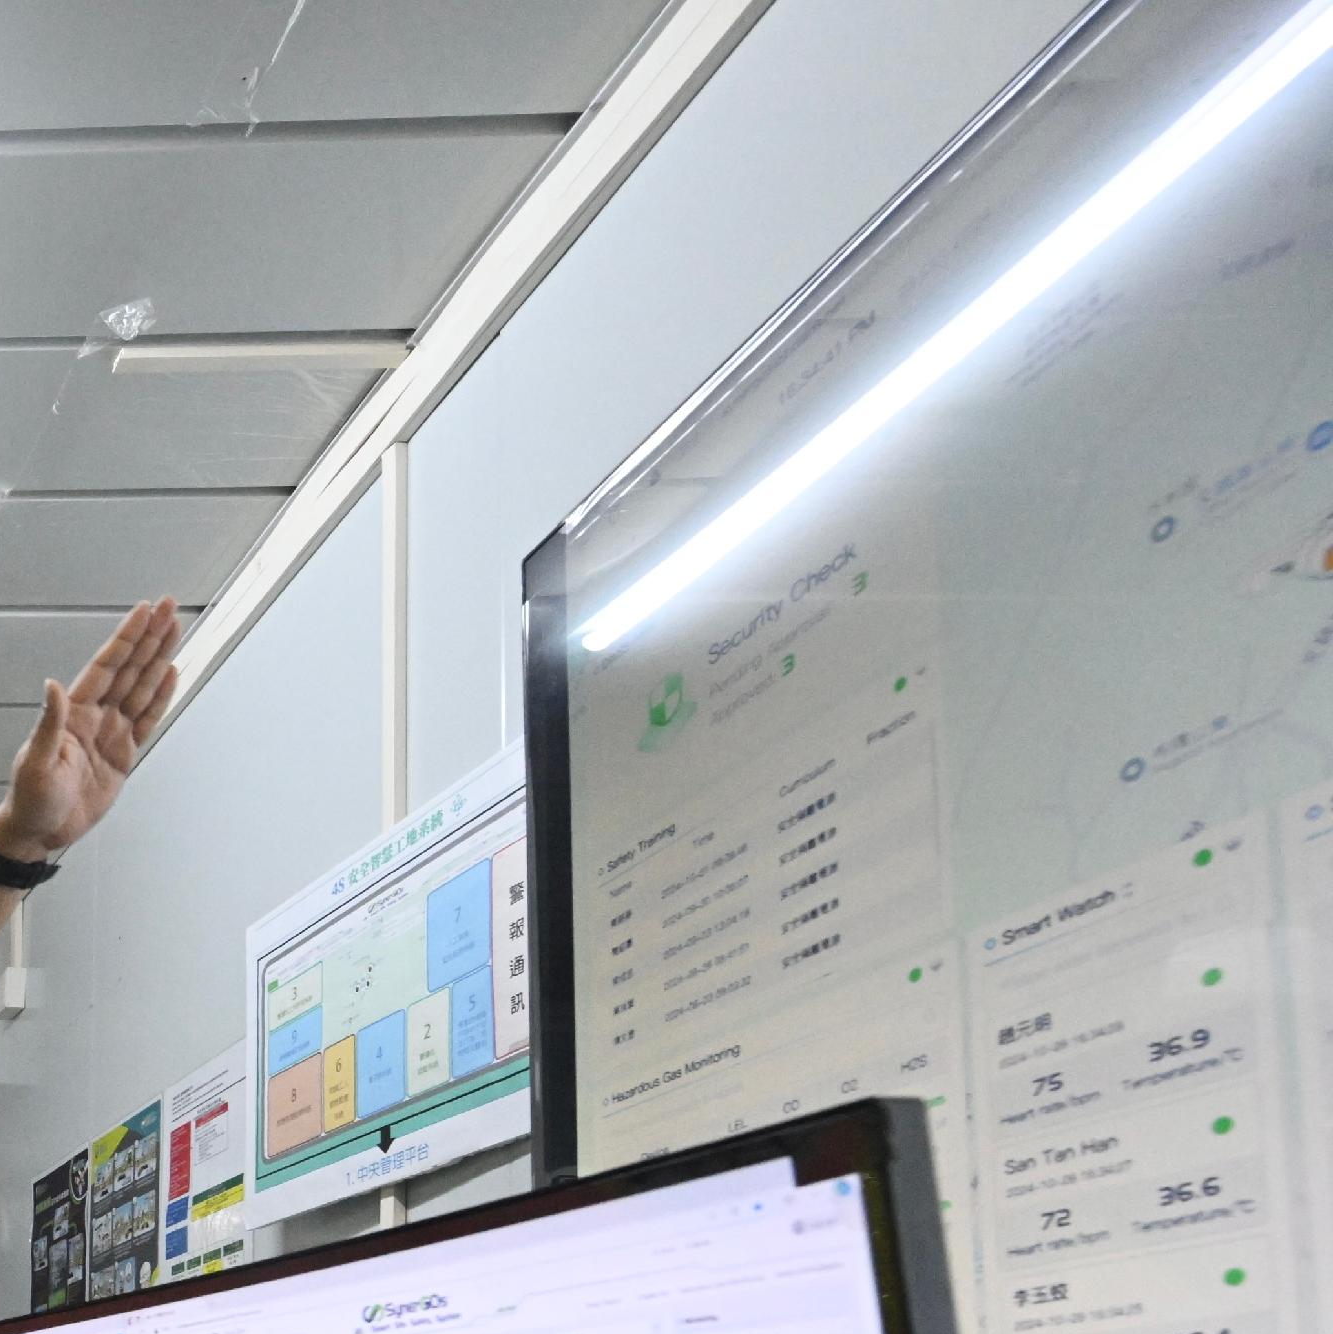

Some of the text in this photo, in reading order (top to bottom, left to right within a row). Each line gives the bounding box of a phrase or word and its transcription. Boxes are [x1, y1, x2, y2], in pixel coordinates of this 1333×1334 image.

[851, 570, 869, 597] 3
[707, 542, 857, 665] Security Check
[780, 652, 796, 678] 3
[452, 904, 462, 924] 7
[1001, 889, 1117, 946] Smart Watch
[423, 1023, 432, 1040] 2
[1146, 1028, 1211, 1063] 36.9
[610, 1044, 742, 1106] Hazardous Gas Monitoring
[1032, 1071, 1065, 1097] 75
[357, 1143, 430, 1182] 中央管理平台
[1158, 1176, 1222, 1207] 36.6
[1040, 1208, 1073, 1231] 72
